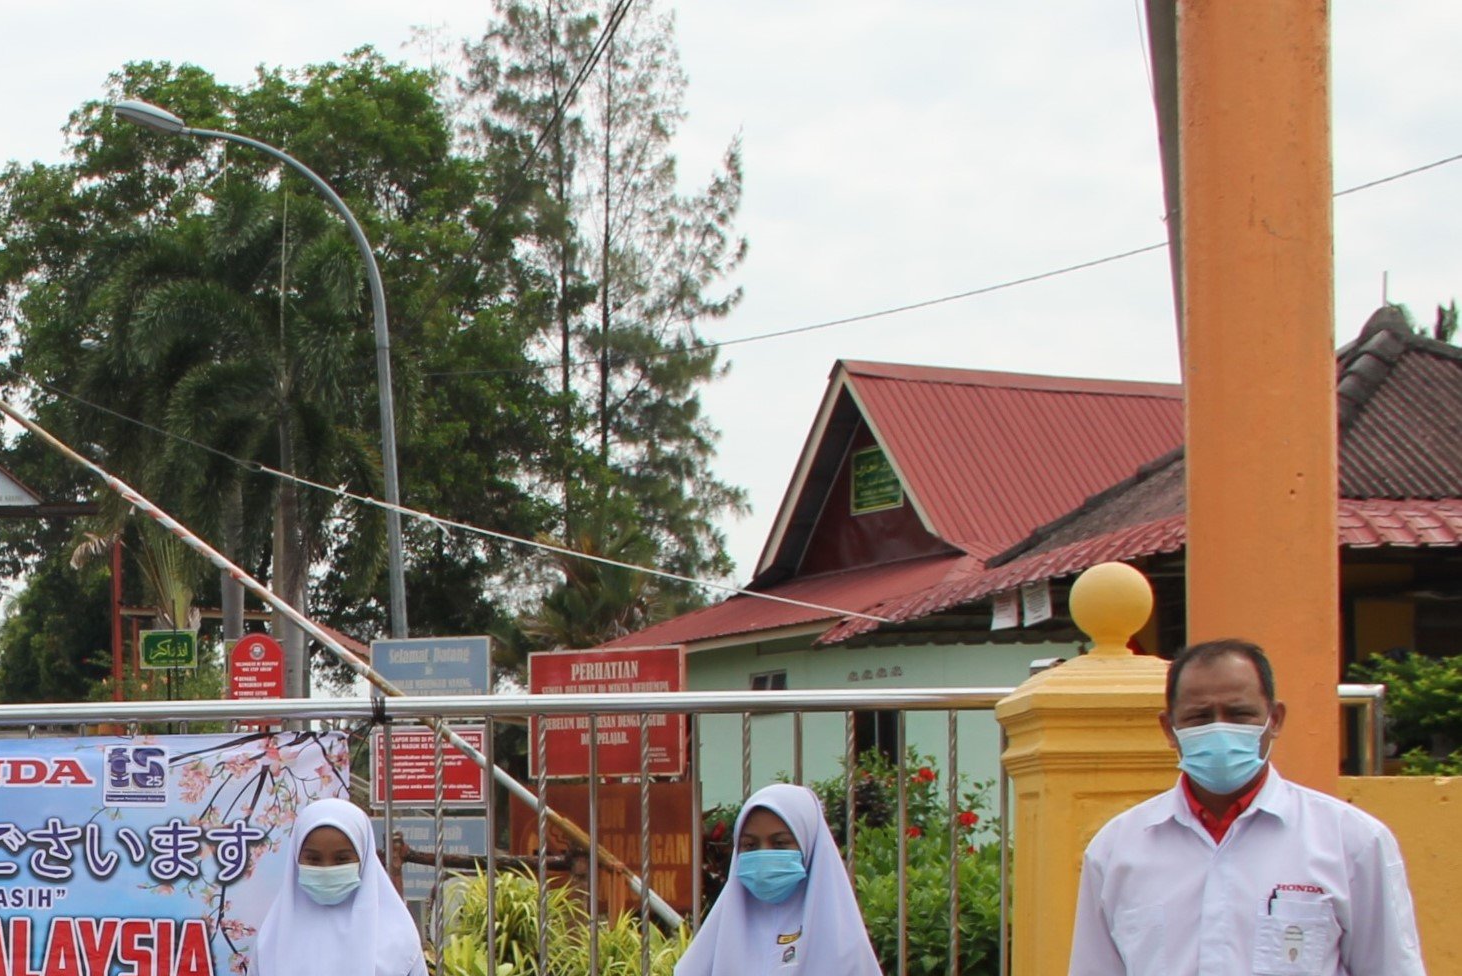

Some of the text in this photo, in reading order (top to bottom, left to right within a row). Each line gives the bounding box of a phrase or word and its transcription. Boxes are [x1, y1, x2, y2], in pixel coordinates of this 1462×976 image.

[571, 661, 638, 681] PERHATIAN
[146, 776, 163, 787] 25
[1276, 884, 1324, 895] HONDA
